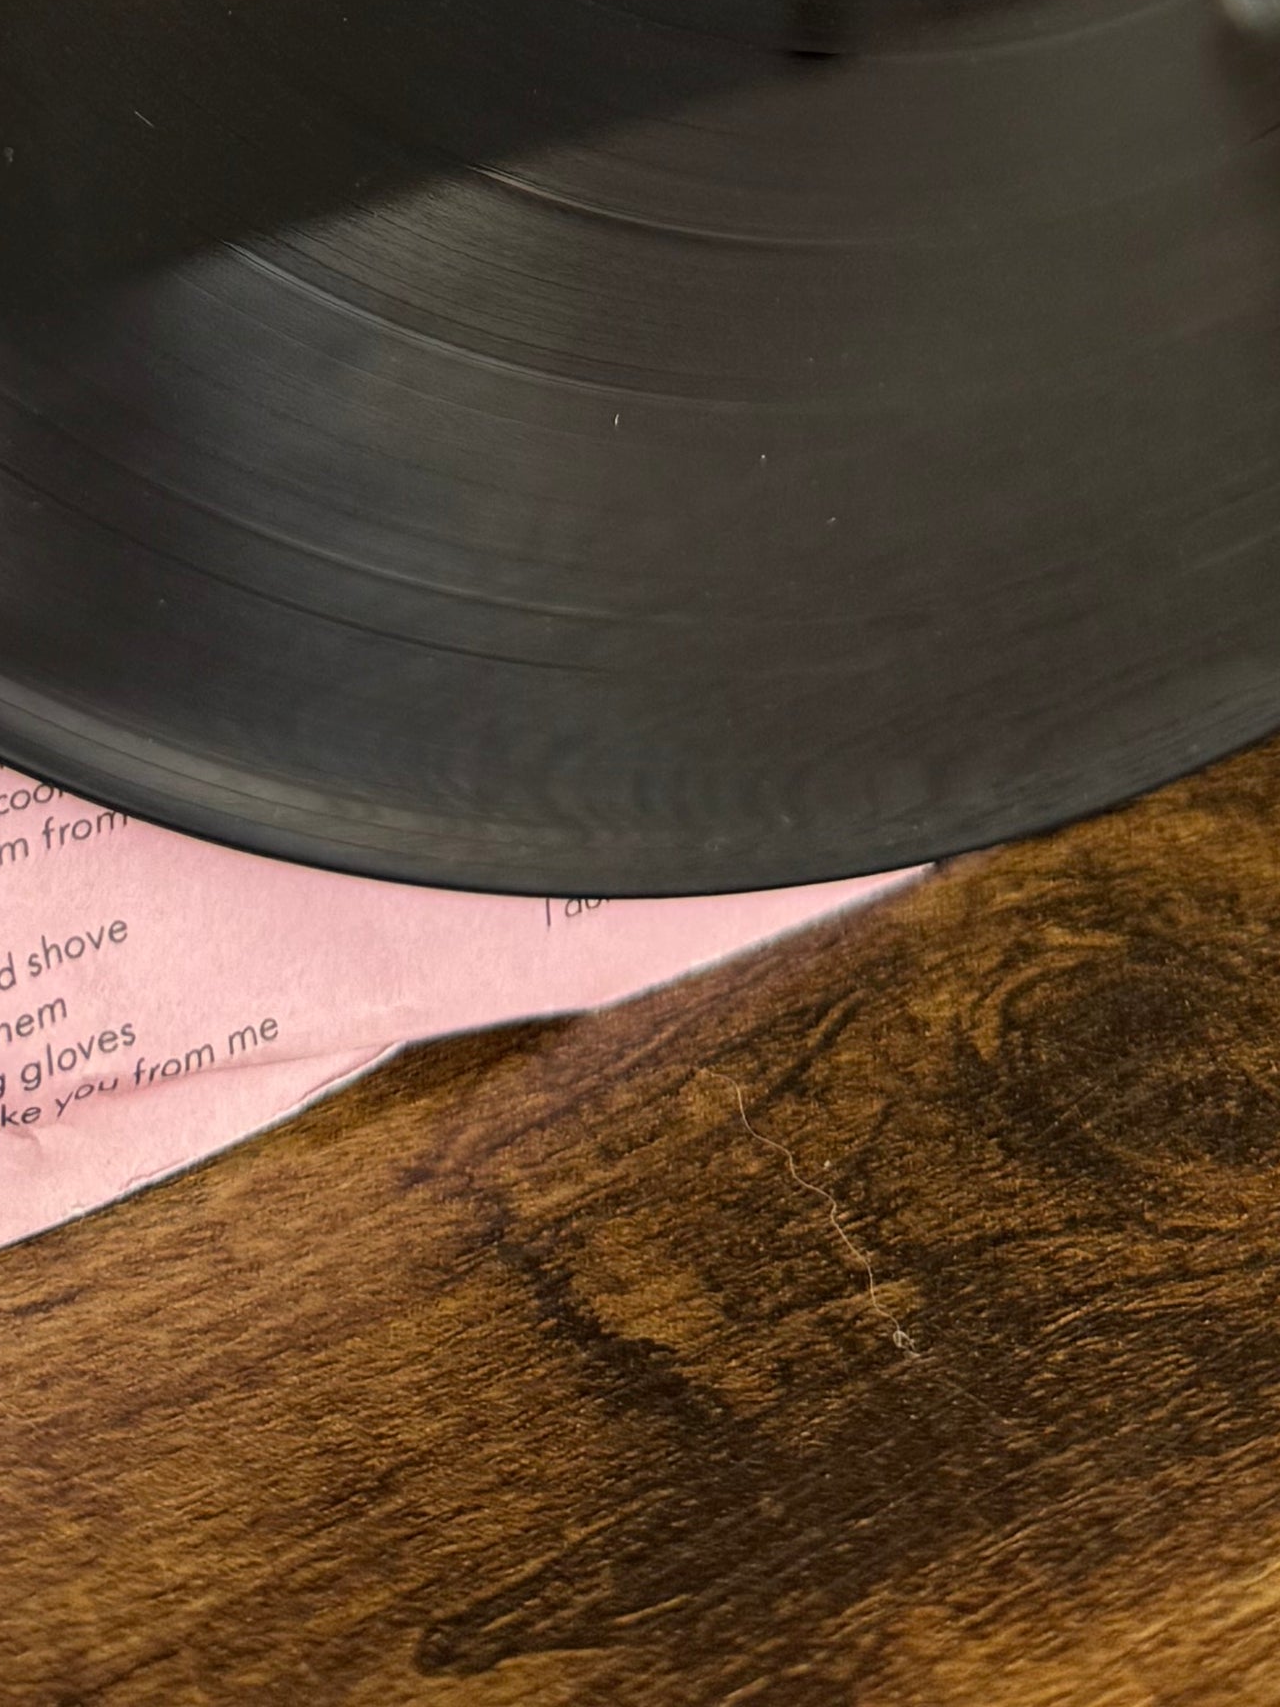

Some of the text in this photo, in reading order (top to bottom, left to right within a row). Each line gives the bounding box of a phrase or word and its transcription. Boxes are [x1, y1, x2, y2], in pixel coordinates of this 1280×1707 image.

[28, 920, 128, 978] shove
[20, 1022, 136, 1090] gloves
[55, 1078, 119, 1117] you
[133, 1043, 215, 1086] from
[228, 1018, 279, 1056] me
